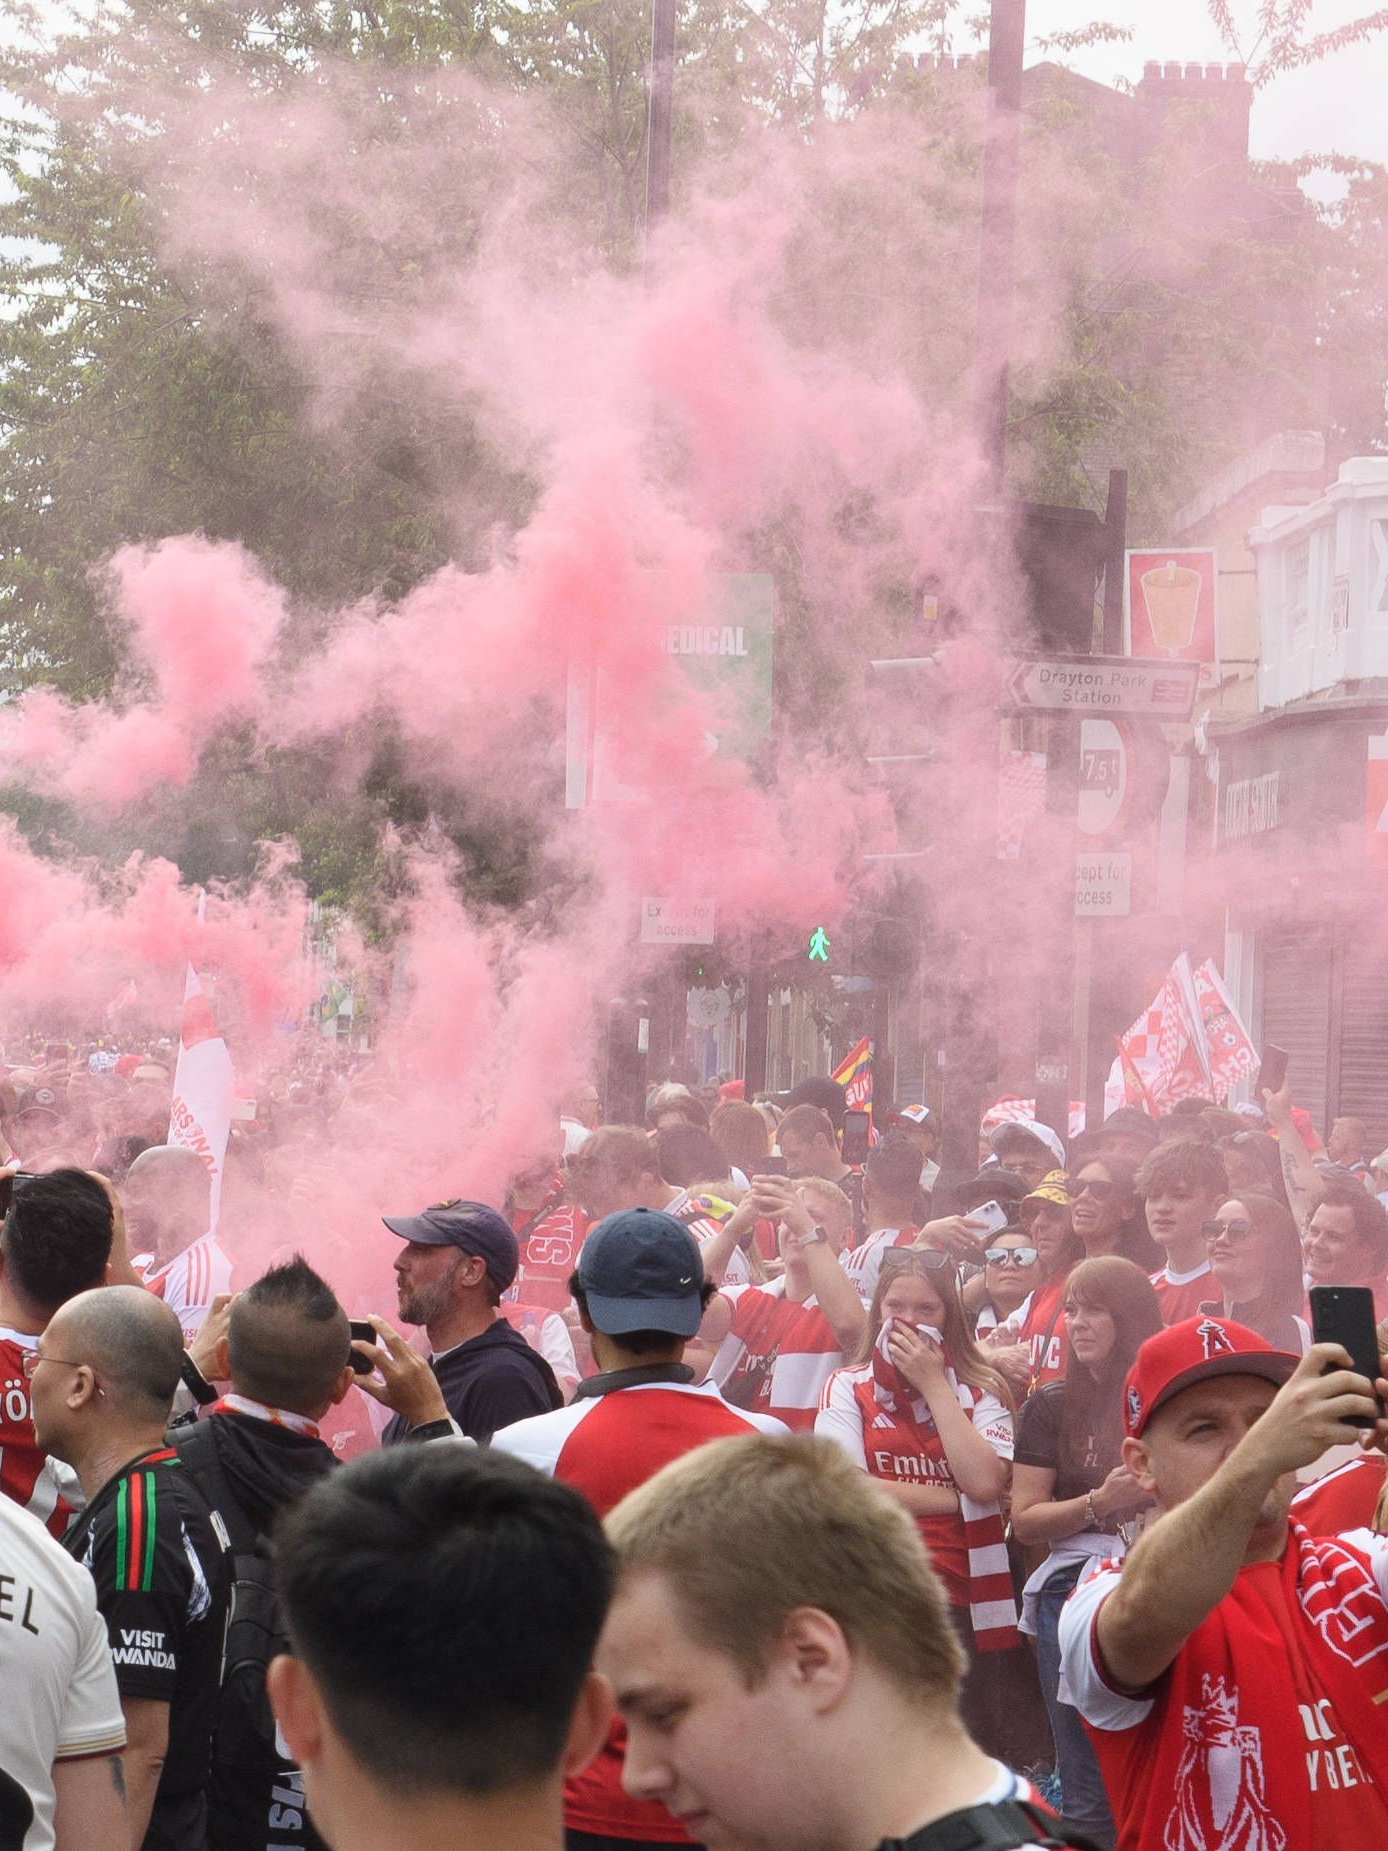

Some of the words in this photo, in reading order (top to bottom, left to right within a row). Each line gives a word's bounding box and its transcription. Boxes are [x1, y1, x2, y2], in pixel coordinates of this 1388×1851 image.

[661, 624, 748, 656] EDICAL
[1039, 669, 1103, 688] Drayton
[1110, 673, 1148, 689] Park
[1062, 689, 1121, 705] Station
[1084, 754, 1107, 781] 7.5
[1107, 861, 1124, 881] for
[657, 926, 699, 937] access
[995, 1423, 1011, 1435] VIS
[119, 1628, 165, 1649] VISIT
[112, 1647, 176, 1670] WANDA
